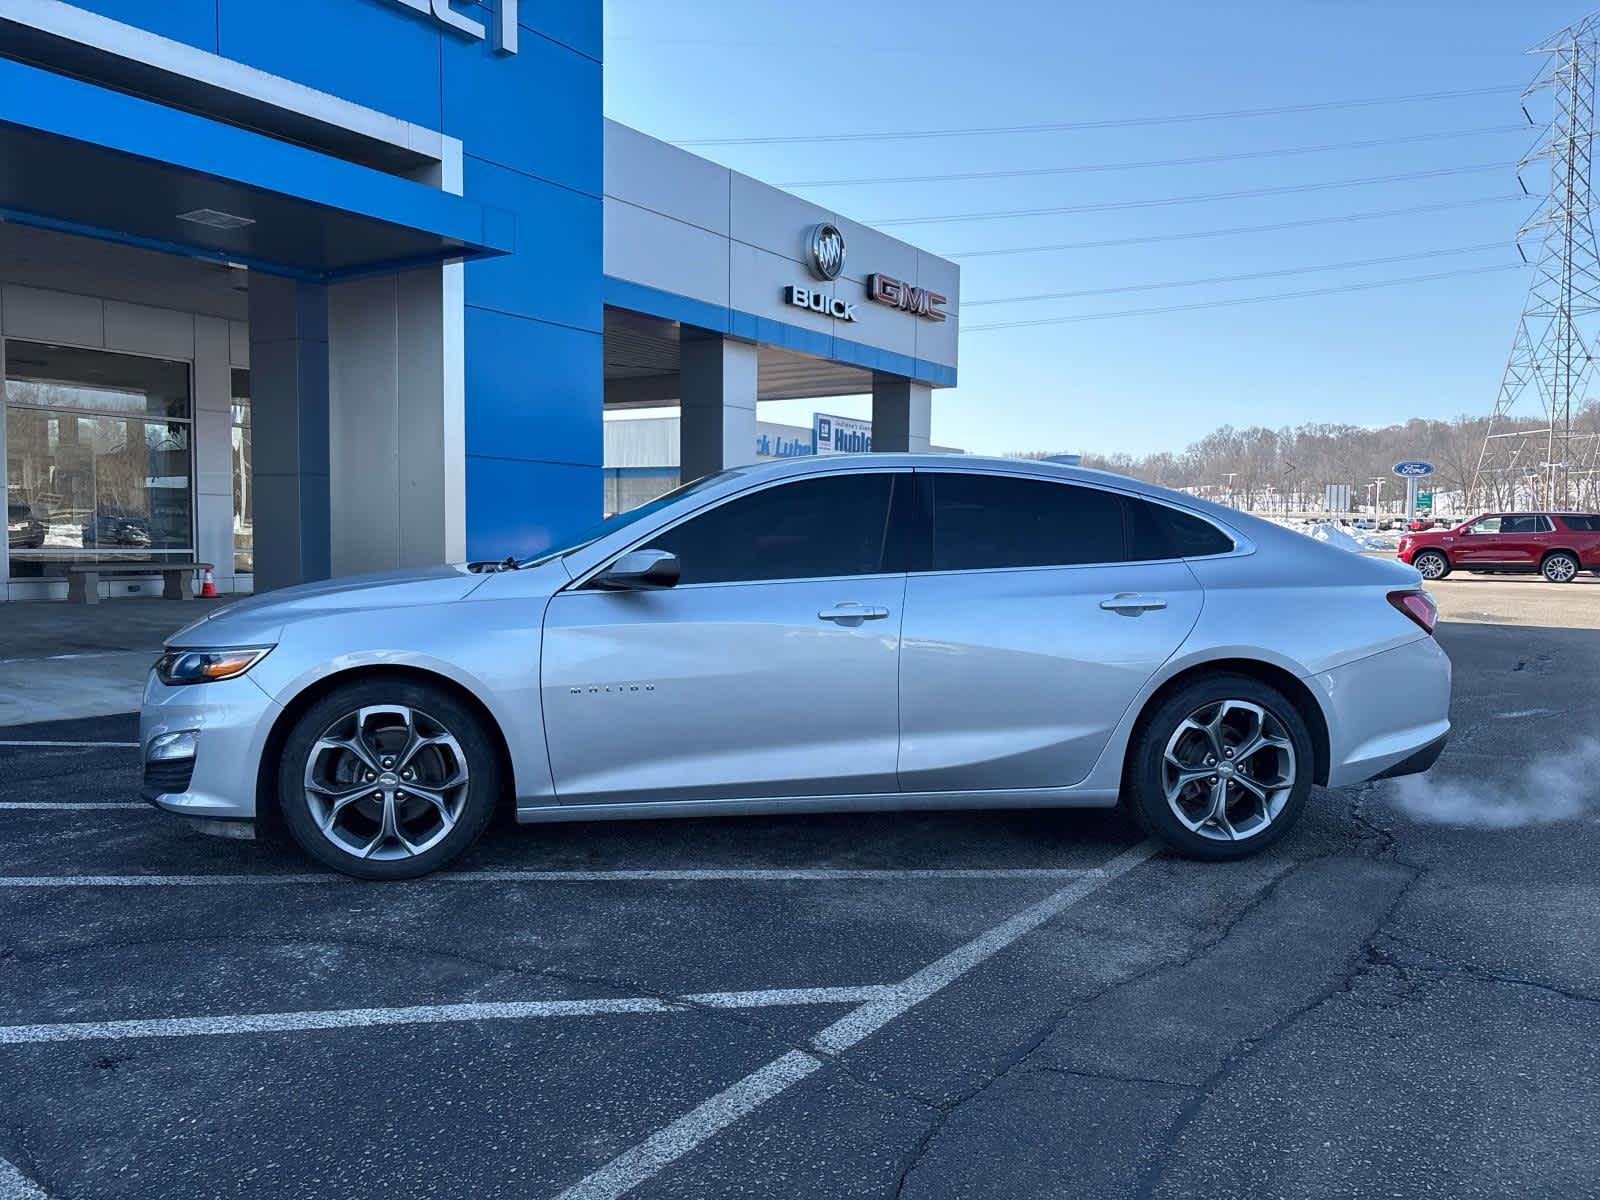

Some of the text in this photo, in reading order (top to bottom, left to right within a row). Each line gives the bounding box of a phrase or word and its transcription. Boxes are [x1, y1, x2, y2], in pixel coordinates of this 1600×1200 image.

[788, 285, 857, 322] BUICK
[869, 272, 947, 322] GMC
[1402, 464, 1426, 474] Ford
[570, 684, 655, 694] MALIBU
